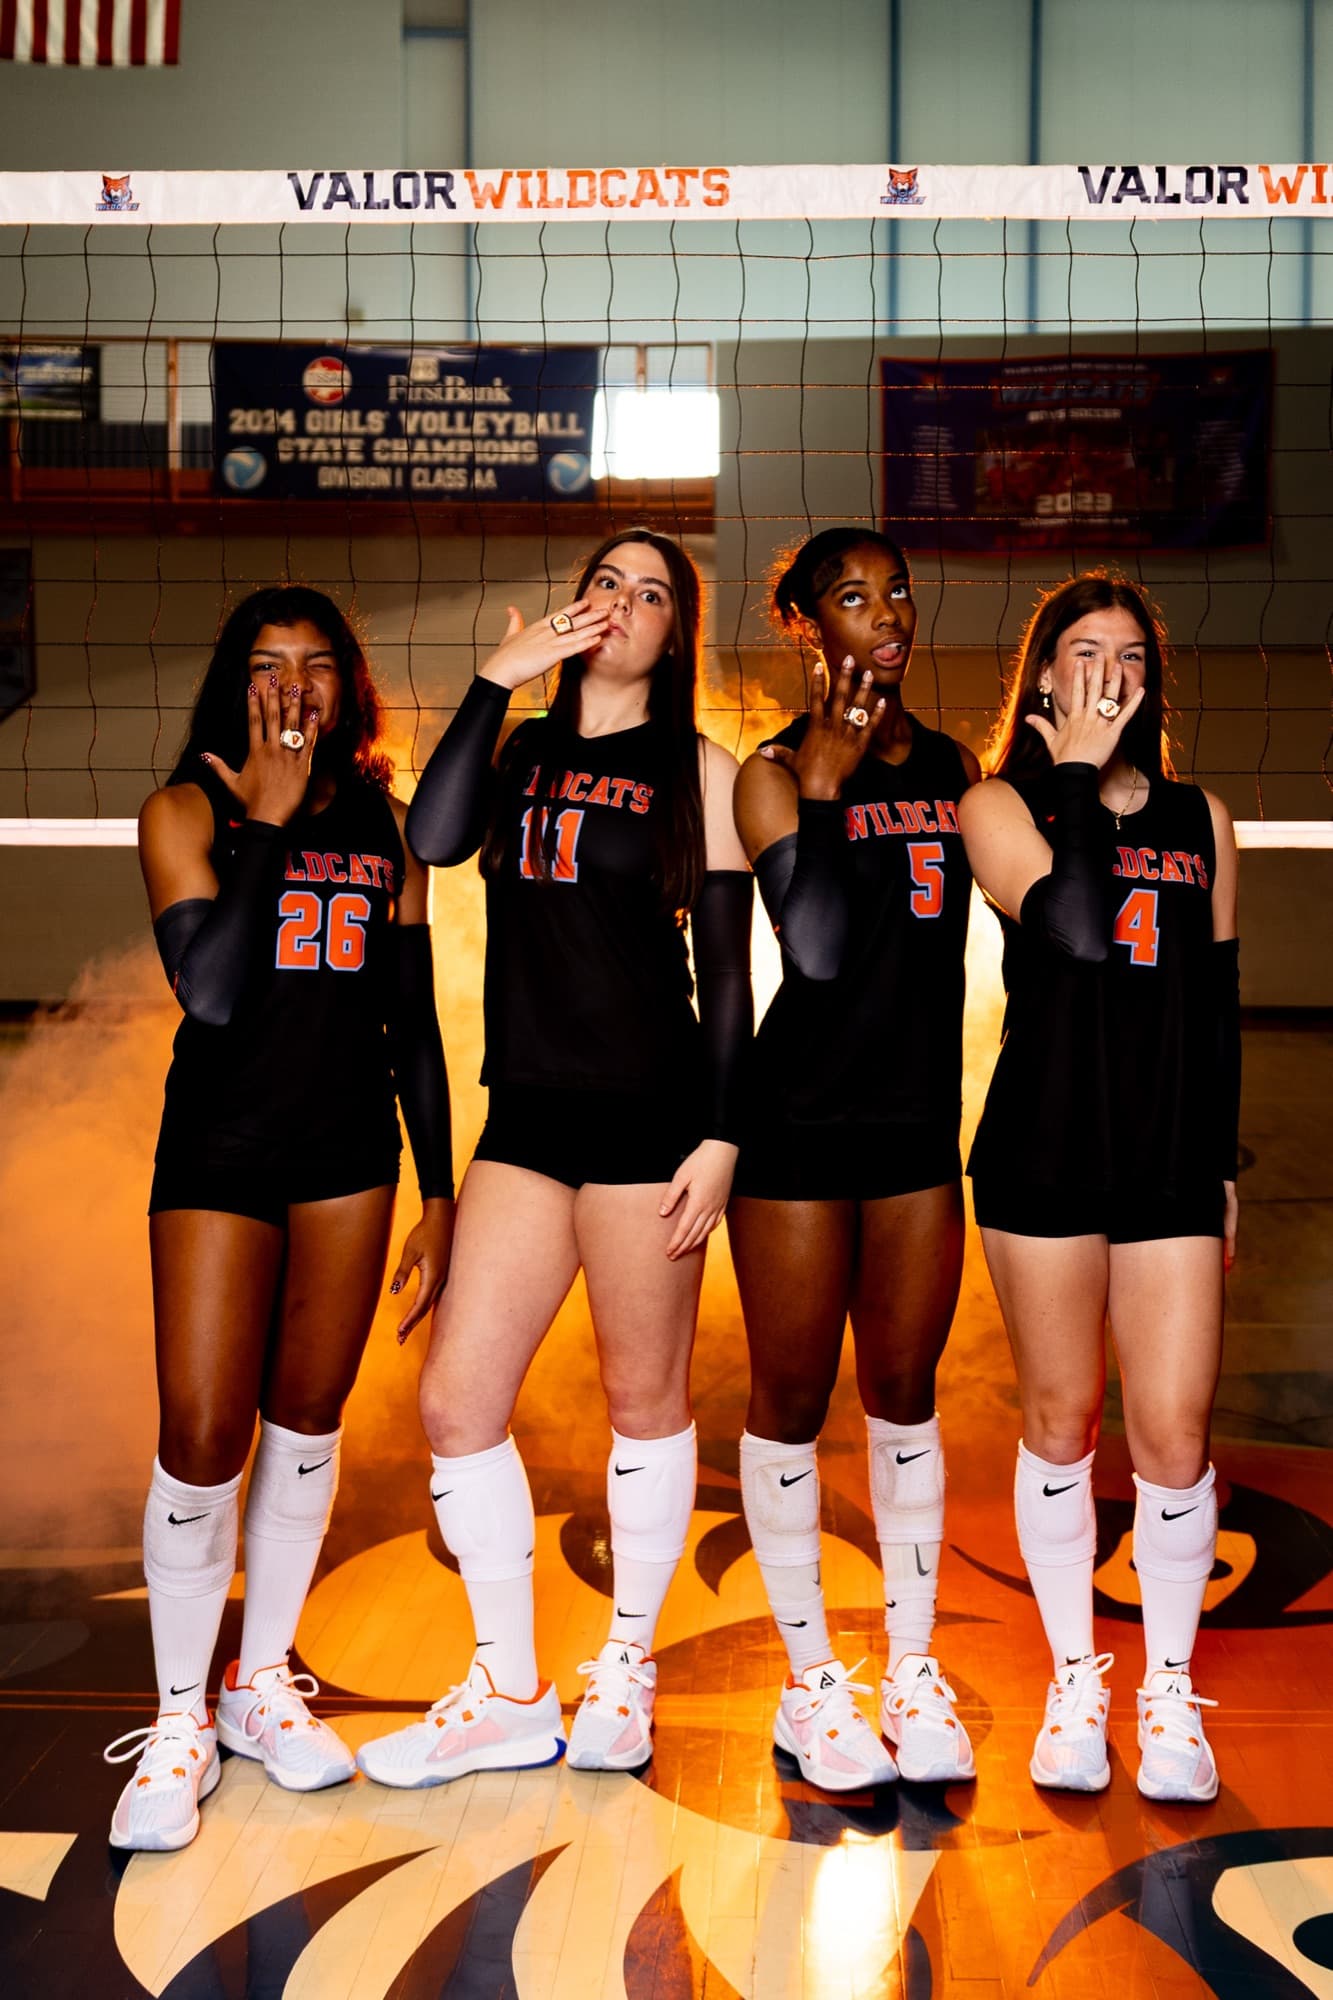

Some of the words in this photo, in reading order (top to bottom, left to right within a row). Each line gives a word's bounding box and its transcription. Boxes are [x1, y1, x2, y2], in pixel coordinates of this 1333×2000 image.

[287, 171, 456, 210] VALOR
[464, 168, 730, 208] WILDCATS
[1078, 166, 1250, 204] VALOR
[1258, 165, 1333, 204] WI
[229, 408, 297, 434] 2024
[398, 410, 585, 437] VOLLEYBALL
[277, 437, 365, 463] STATE
[372, 438, 539, 465] CHAMPIONS
[317, 466, 392, 488] DIVISION
[411, 467, 469, 489] CLASS
[1035, 491, 1112, 514] 2023
[906, 841, 945, 918] 5
[275, 890, 371, 971] 26
[1113, 888, 1160, 966] 4
